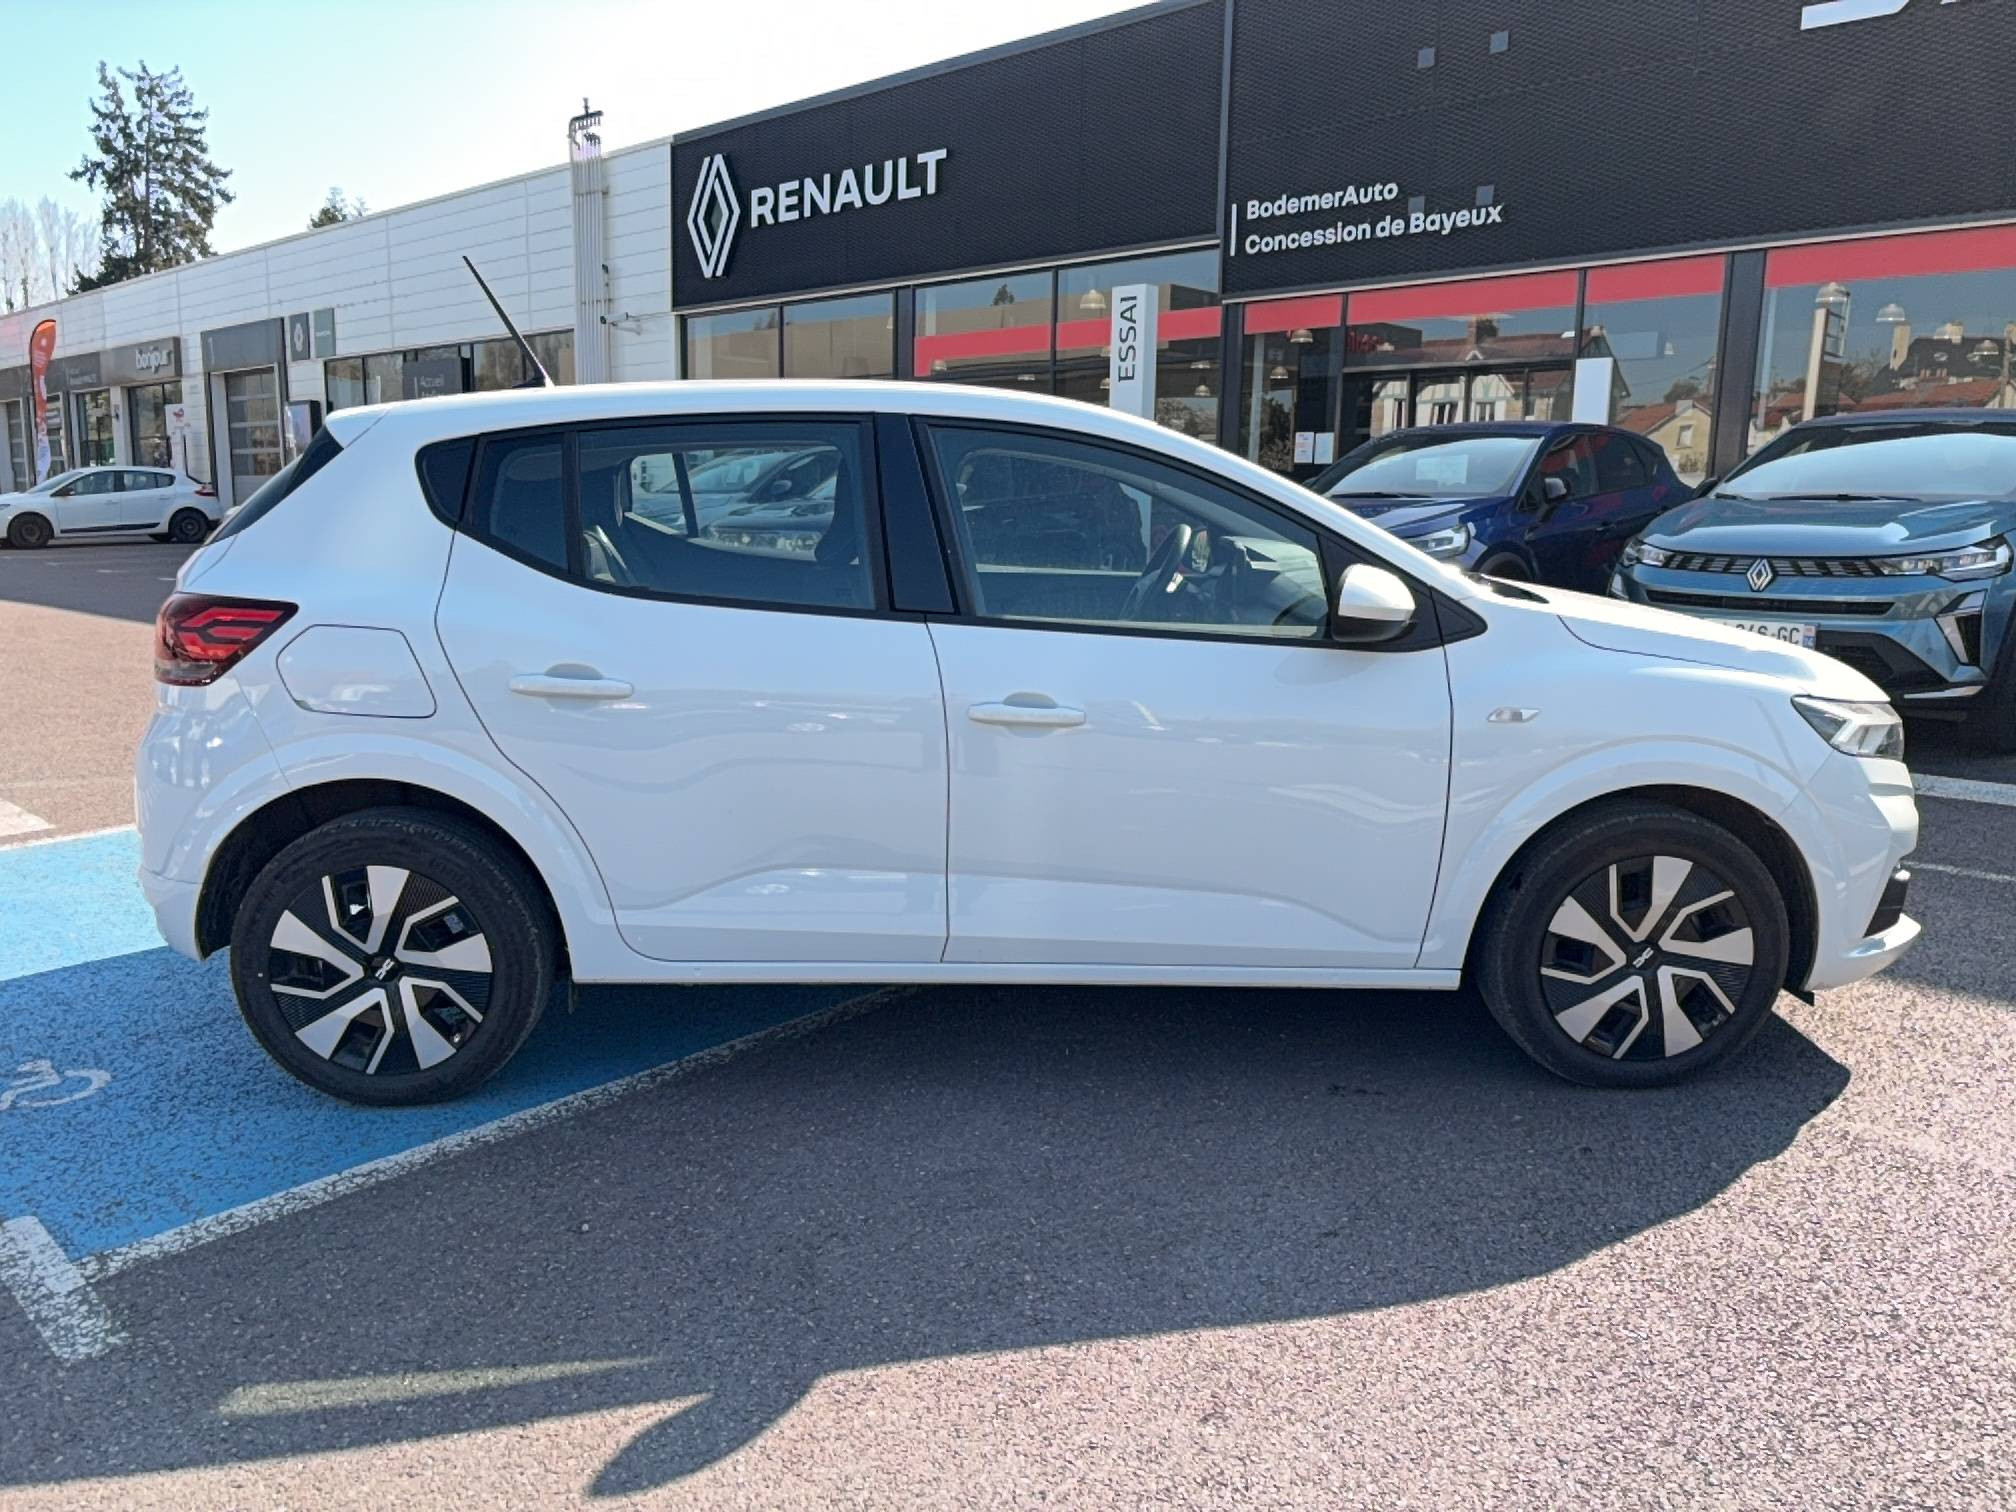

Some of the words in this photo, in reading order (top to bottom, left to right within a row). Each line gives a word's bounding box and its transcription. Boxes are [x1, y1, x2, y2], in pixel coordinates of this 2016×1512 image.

[750, 147, 948, 229] RENAULT
[1246, 182, 1399, 220] BodemerAuto
[1244, 221, 1371, 255] Concession
[1375, 215, 1405, 238] de
[1408, 202, 1505, 236] Bayeux
[1117, 295, 1138, 383] ESSAI
